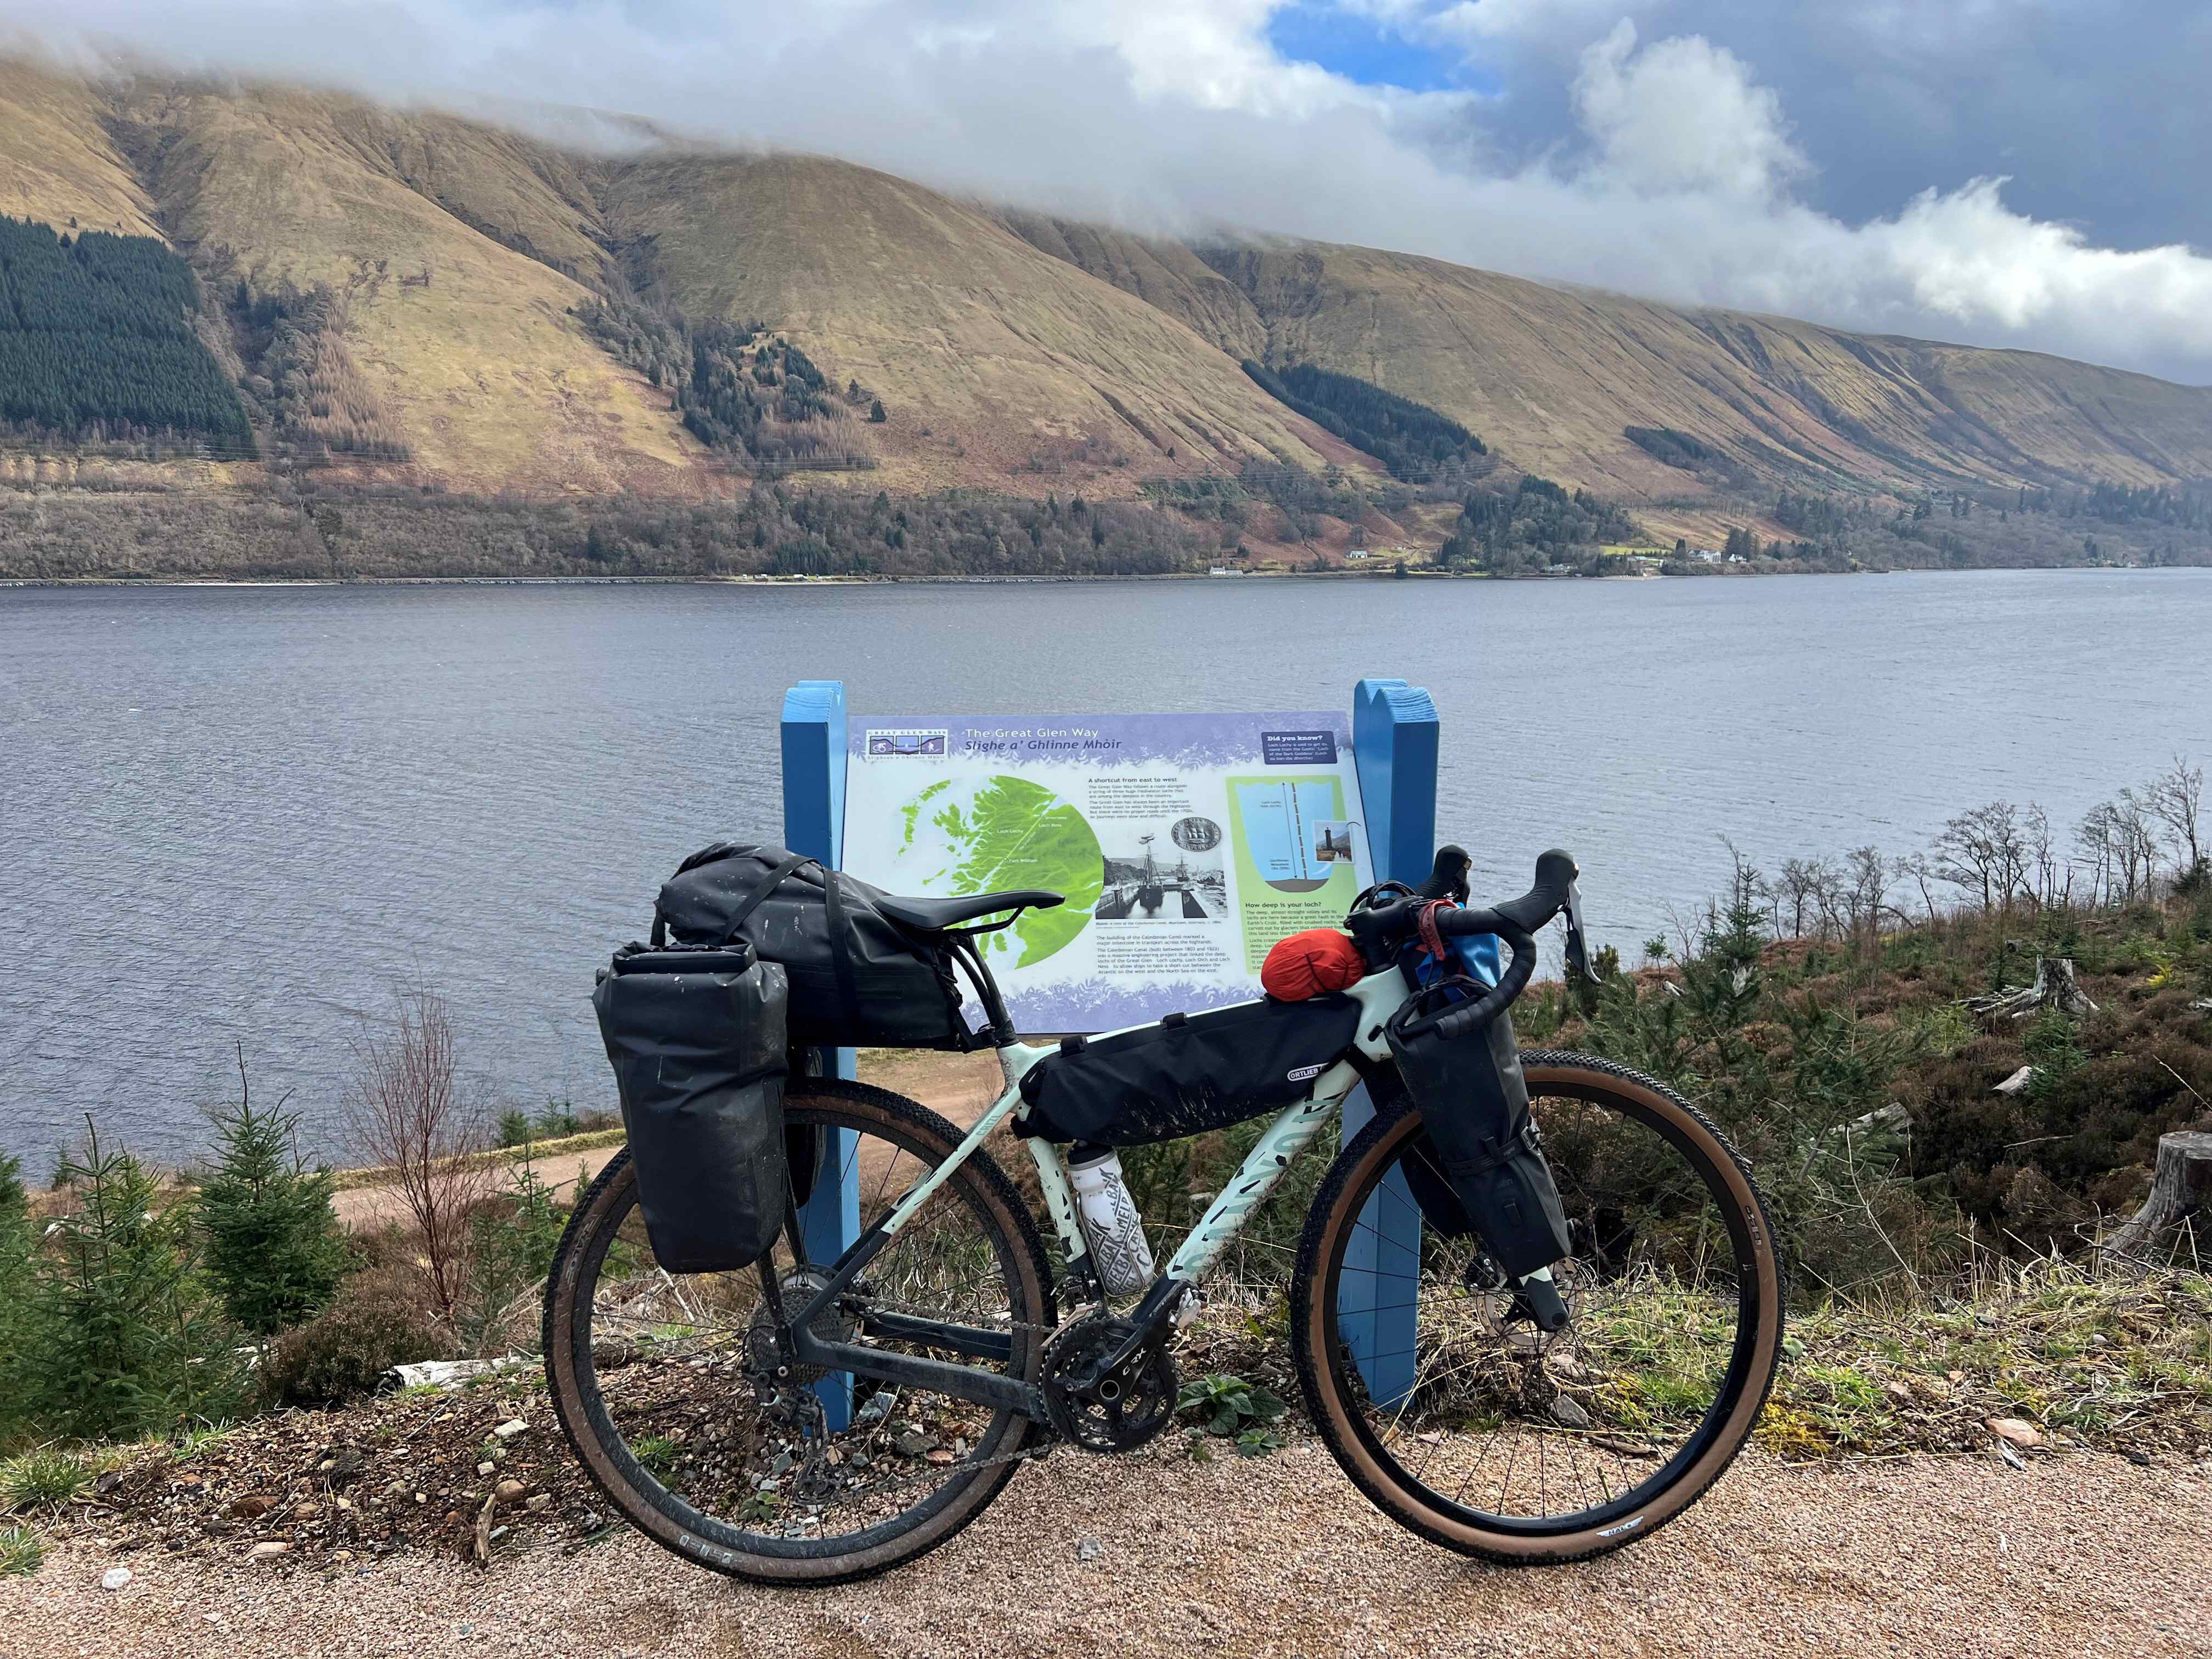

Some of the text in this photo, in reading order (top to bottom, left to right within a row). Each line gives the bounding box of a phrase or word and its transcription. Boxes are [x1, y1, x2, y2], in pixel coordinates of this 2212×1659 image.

[966, 728, 1099, 738] The Great Glen Way
[966, 741, 1005, 752] Slighe
[1028, 740, 1079, 750] Ghlinne
[1290, 1068, 1318, 1079] ORTLIEB
